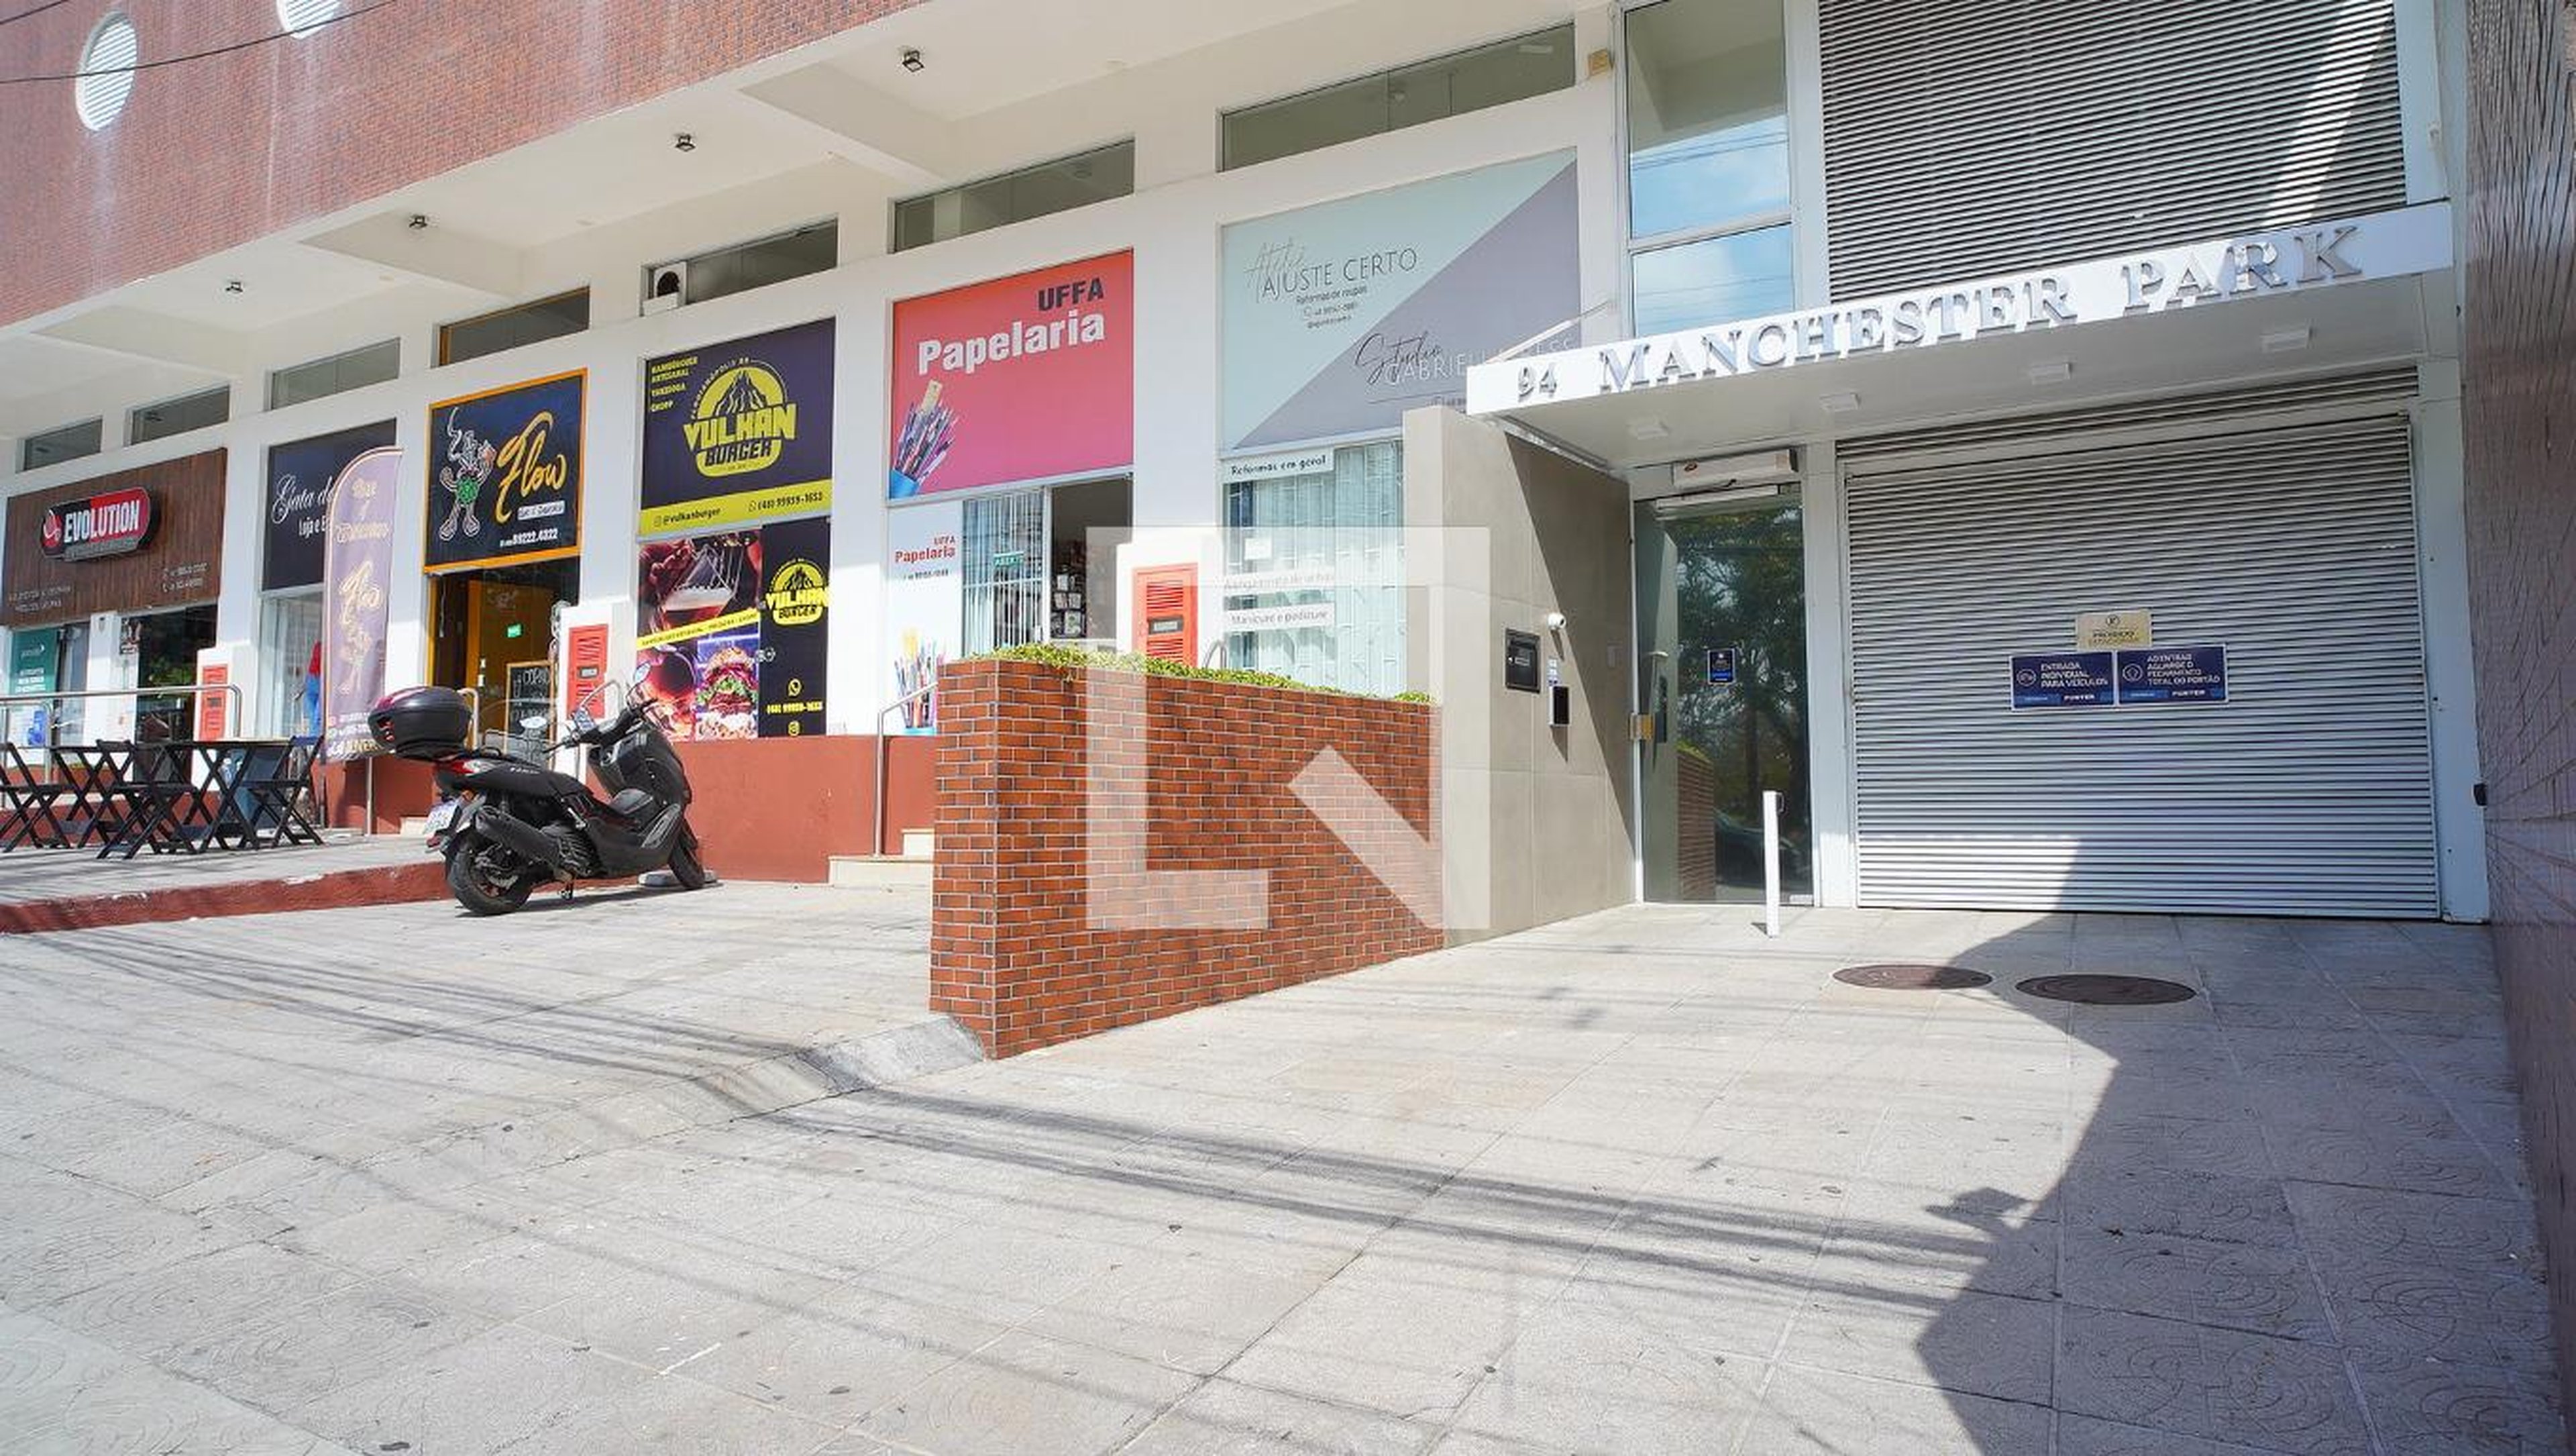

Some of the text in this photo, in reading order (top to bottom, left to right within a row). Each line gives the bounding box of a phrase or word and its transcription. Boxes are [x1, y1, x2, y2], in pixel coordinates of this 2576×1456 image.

[1262, 247, 1418, 301] AJUSTE CERTO
[1038, 277, 1104, 312] UFFA
[1517, 225, 2363, 403] 94 MANCHESTER PARK
[918, 310, 1106, 376] Papelaria
[683, 403, 798, 452] VULKAN
[495, 411, 568, 523] Flow
[704, 439, 772, 467] BURGER
[64, 499, 141, 543] EVOLUTION
[894, 545, 956, 564] Papelaria
[765, 585, 831, 610] VULKAN
[778, 605, 818, 619] BURGER
[2041, 662, 2082, 671] ENTRADA
